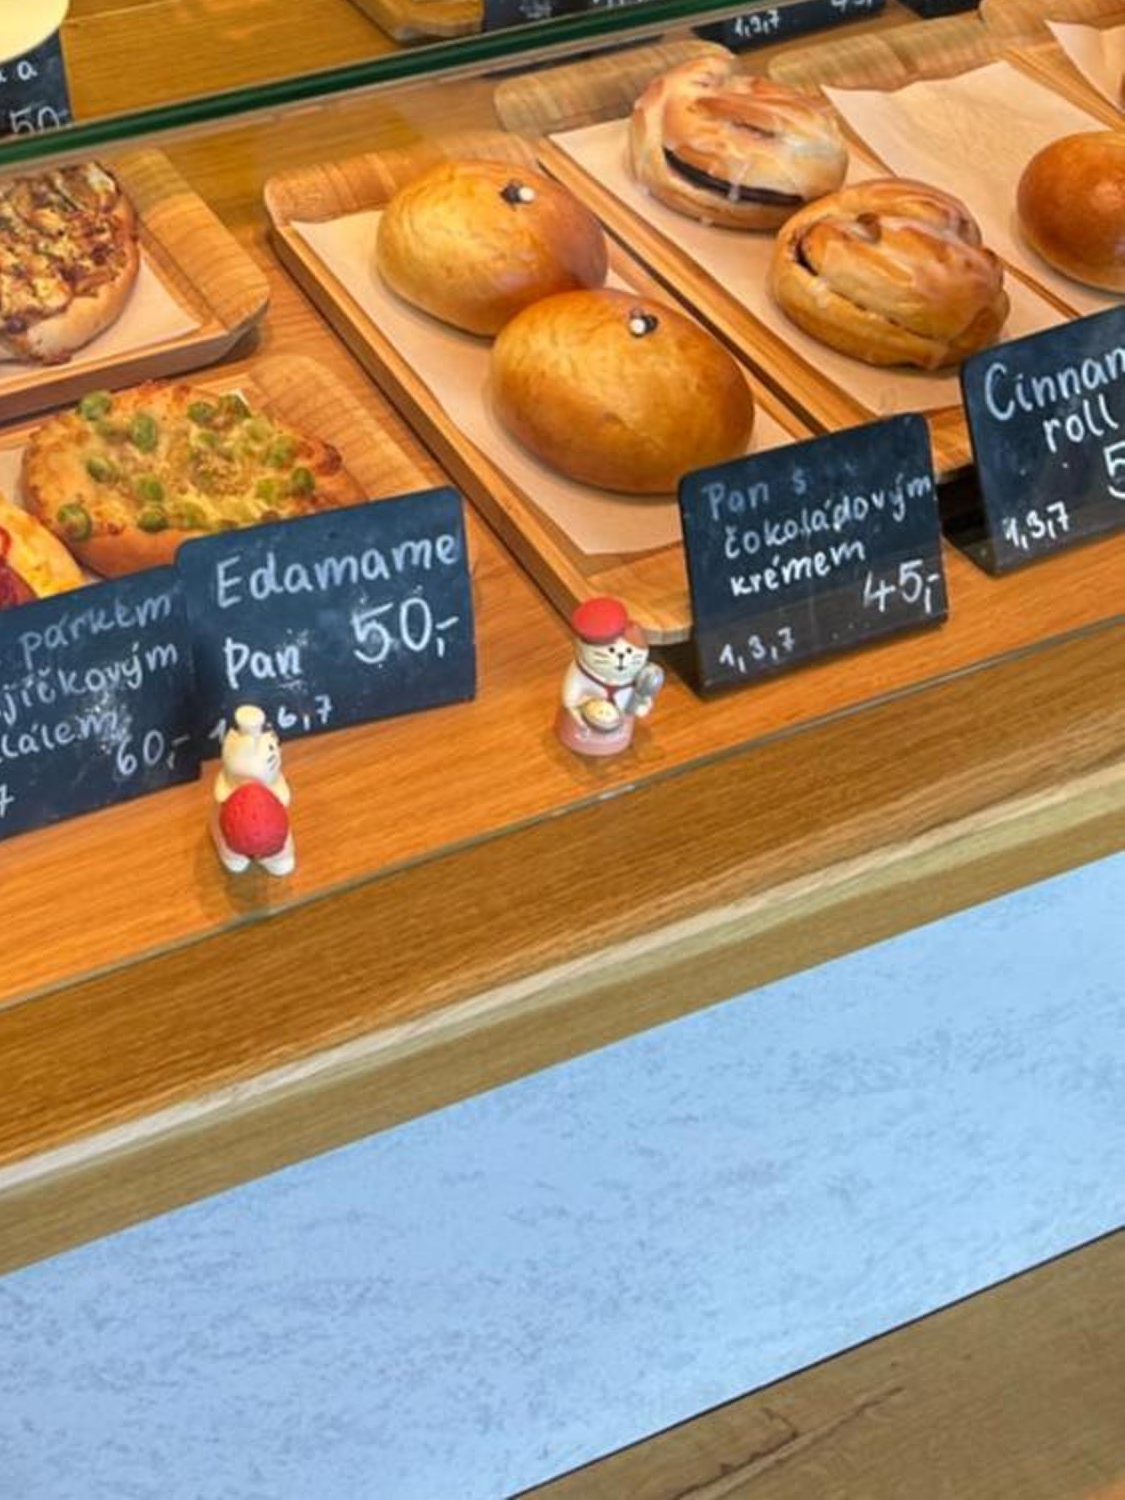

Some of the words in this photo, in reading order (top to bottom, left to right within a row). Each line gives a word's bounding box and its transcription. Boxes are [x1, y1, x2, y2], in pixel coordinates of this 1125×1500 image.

[16, 60, 38, 81] a
[1043, 392, 1119, 453] roll
[792, 470, 808, 494] s
[725, 470, 935, 559] čokoládovým
[216, 533, 459, 609] Edamame
[730, 538, 867, 598] krémem
[350, 597, 460, 664] 50,-
[718, 625, 797, 674] 1,3,7
